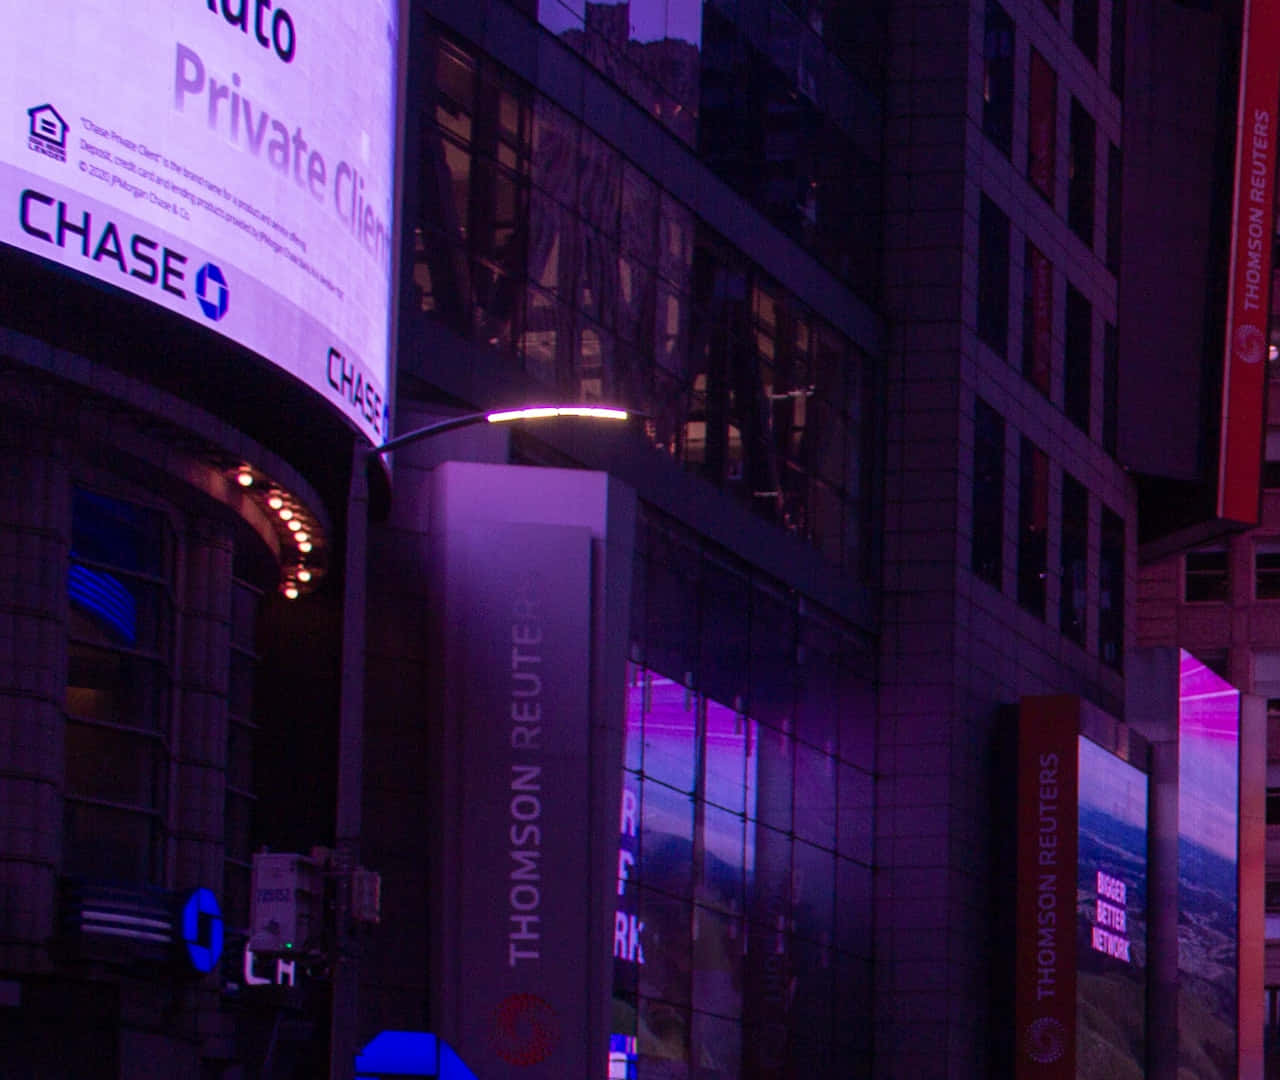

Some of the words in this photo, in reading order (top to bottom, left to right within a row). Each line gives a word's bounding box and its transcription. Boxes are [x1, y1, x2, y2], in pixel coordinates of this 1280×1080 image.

[207, 0, 296, 63] uto
[175, 41, 328, 203] Private
[335, 160, 389, 264] Clien
[1252, 108, 1271, 203] REUTERS
[20, 188, 188, 300] CHASE
[1242, 207, 1265, 312] THOMSON
[325, 346, 385, 435] CHASE
[510, 754, 542, 968] THOMSON
[1039, 752, 1058, 866] REUTERS
[1036, 868, 1058, 1002] THOMSON
